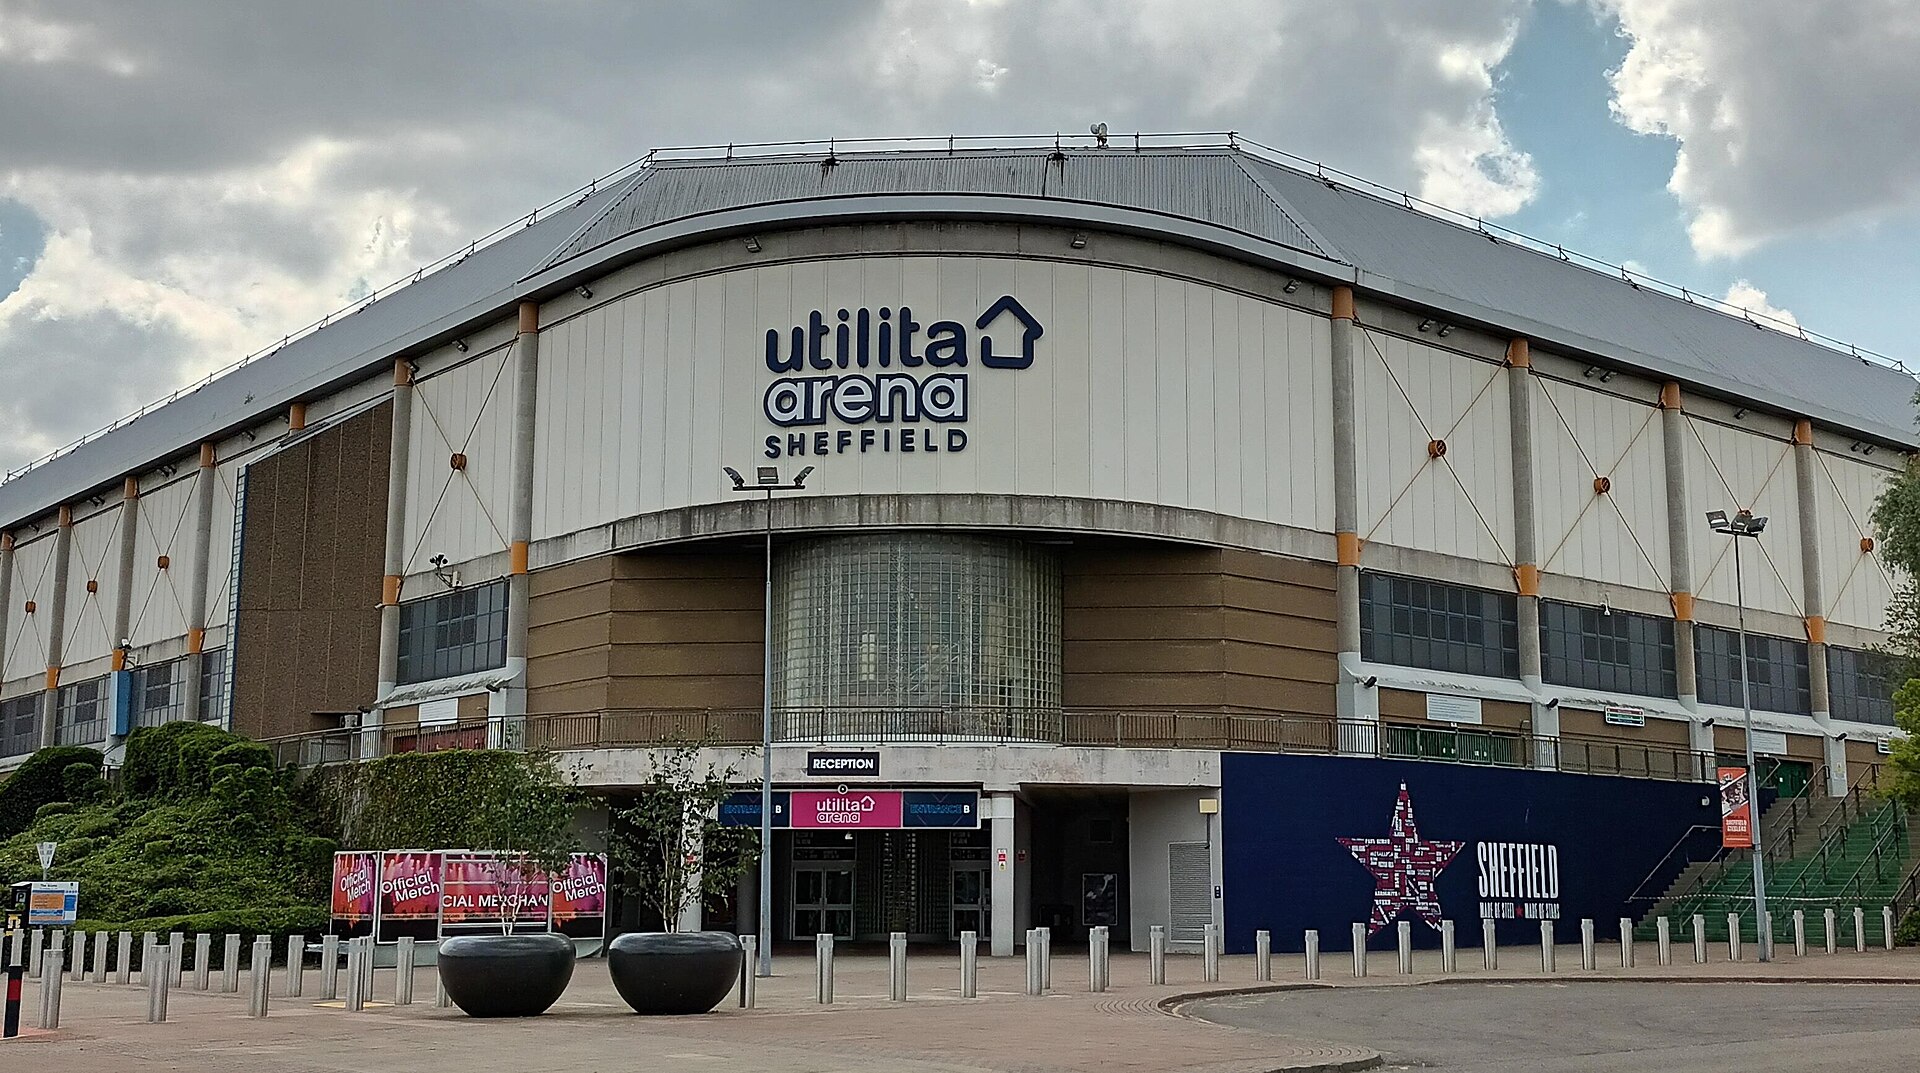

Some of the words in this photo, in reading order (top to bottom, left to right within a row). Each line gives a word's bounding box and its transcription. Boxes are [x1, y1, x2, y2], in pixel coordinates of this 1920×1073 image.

[765, 306, 968, 373] utilita
[763, 372, 968, 427] arena
[764, 428, 968, 459] SHEFFIELD
[812, 758, 874, 769] RECEPTION
[775, 804, 782, 814] B
[816, 798, 860, 812] utilita
[909, 804, 962, 814] ENTRANCE
[963, 804, 970, 814] B
[816, 811, 861, 824] arena
[340, 868, 368, 892] Official
[1477, 841, 1559, 899] SHEFFIELD
[347, 878, 371, 902] Merch
[381, 870, 432, 894] Official
[395, 882, 440, 902] Merch
[552, 871, 598, 893] Official
[565, 882, 605, 902] Merch
[442, 894, 475, 908] CIAL
